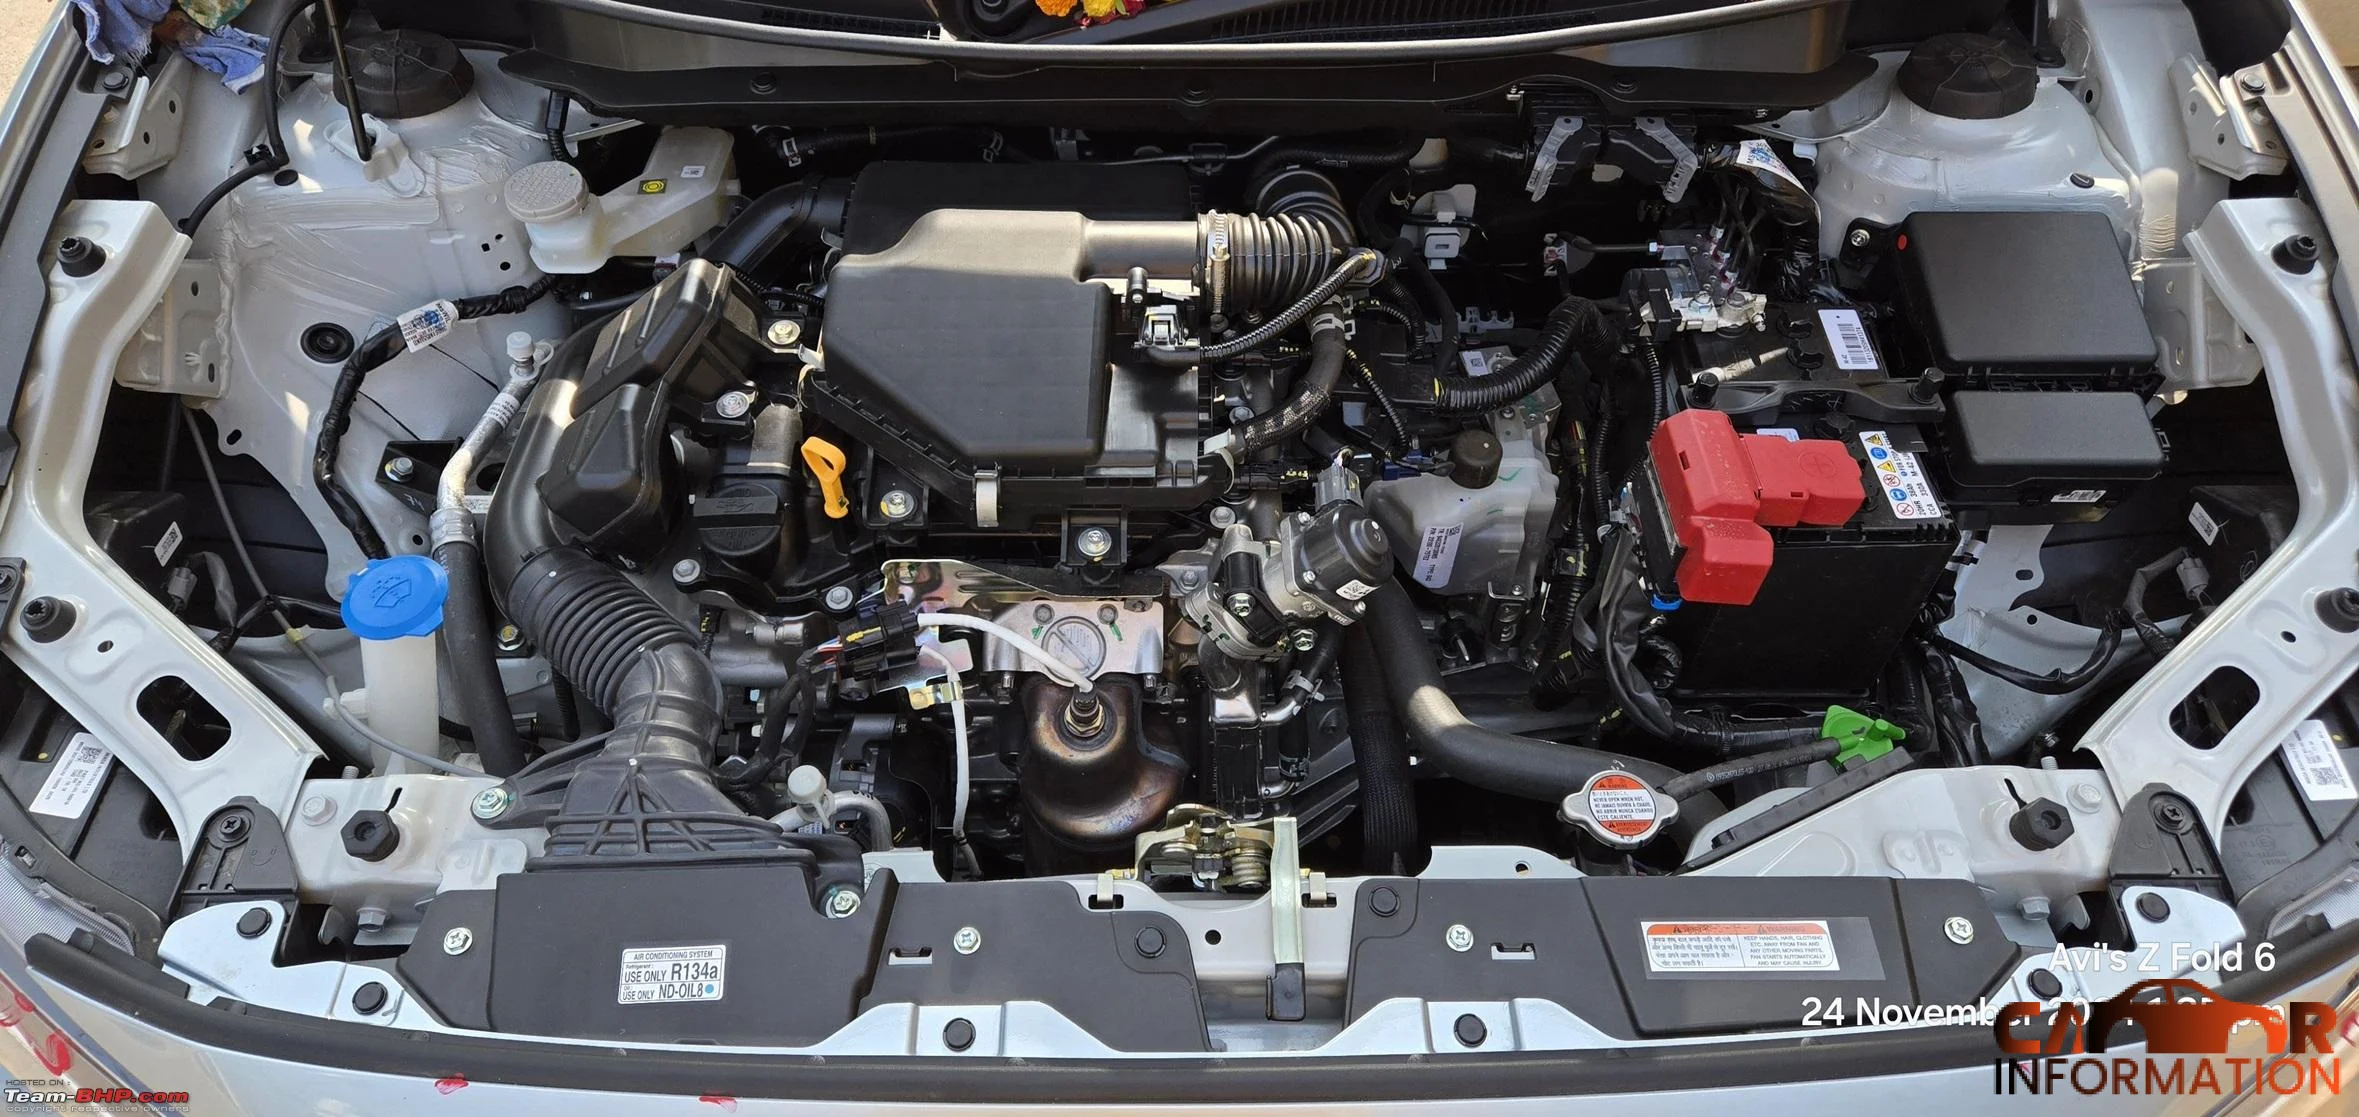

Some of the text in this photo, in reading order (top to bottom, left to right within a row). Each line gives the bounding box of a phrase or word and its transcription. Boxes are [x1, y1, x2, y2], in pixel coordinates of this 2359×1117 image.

[634, 950, 713, 961] AIR CONDITIONING SYSTEM
[624, 961, 718, 983] USE ONLY R134a
[622, 982, 704, 1001] USE ONLY ND-OIL8
